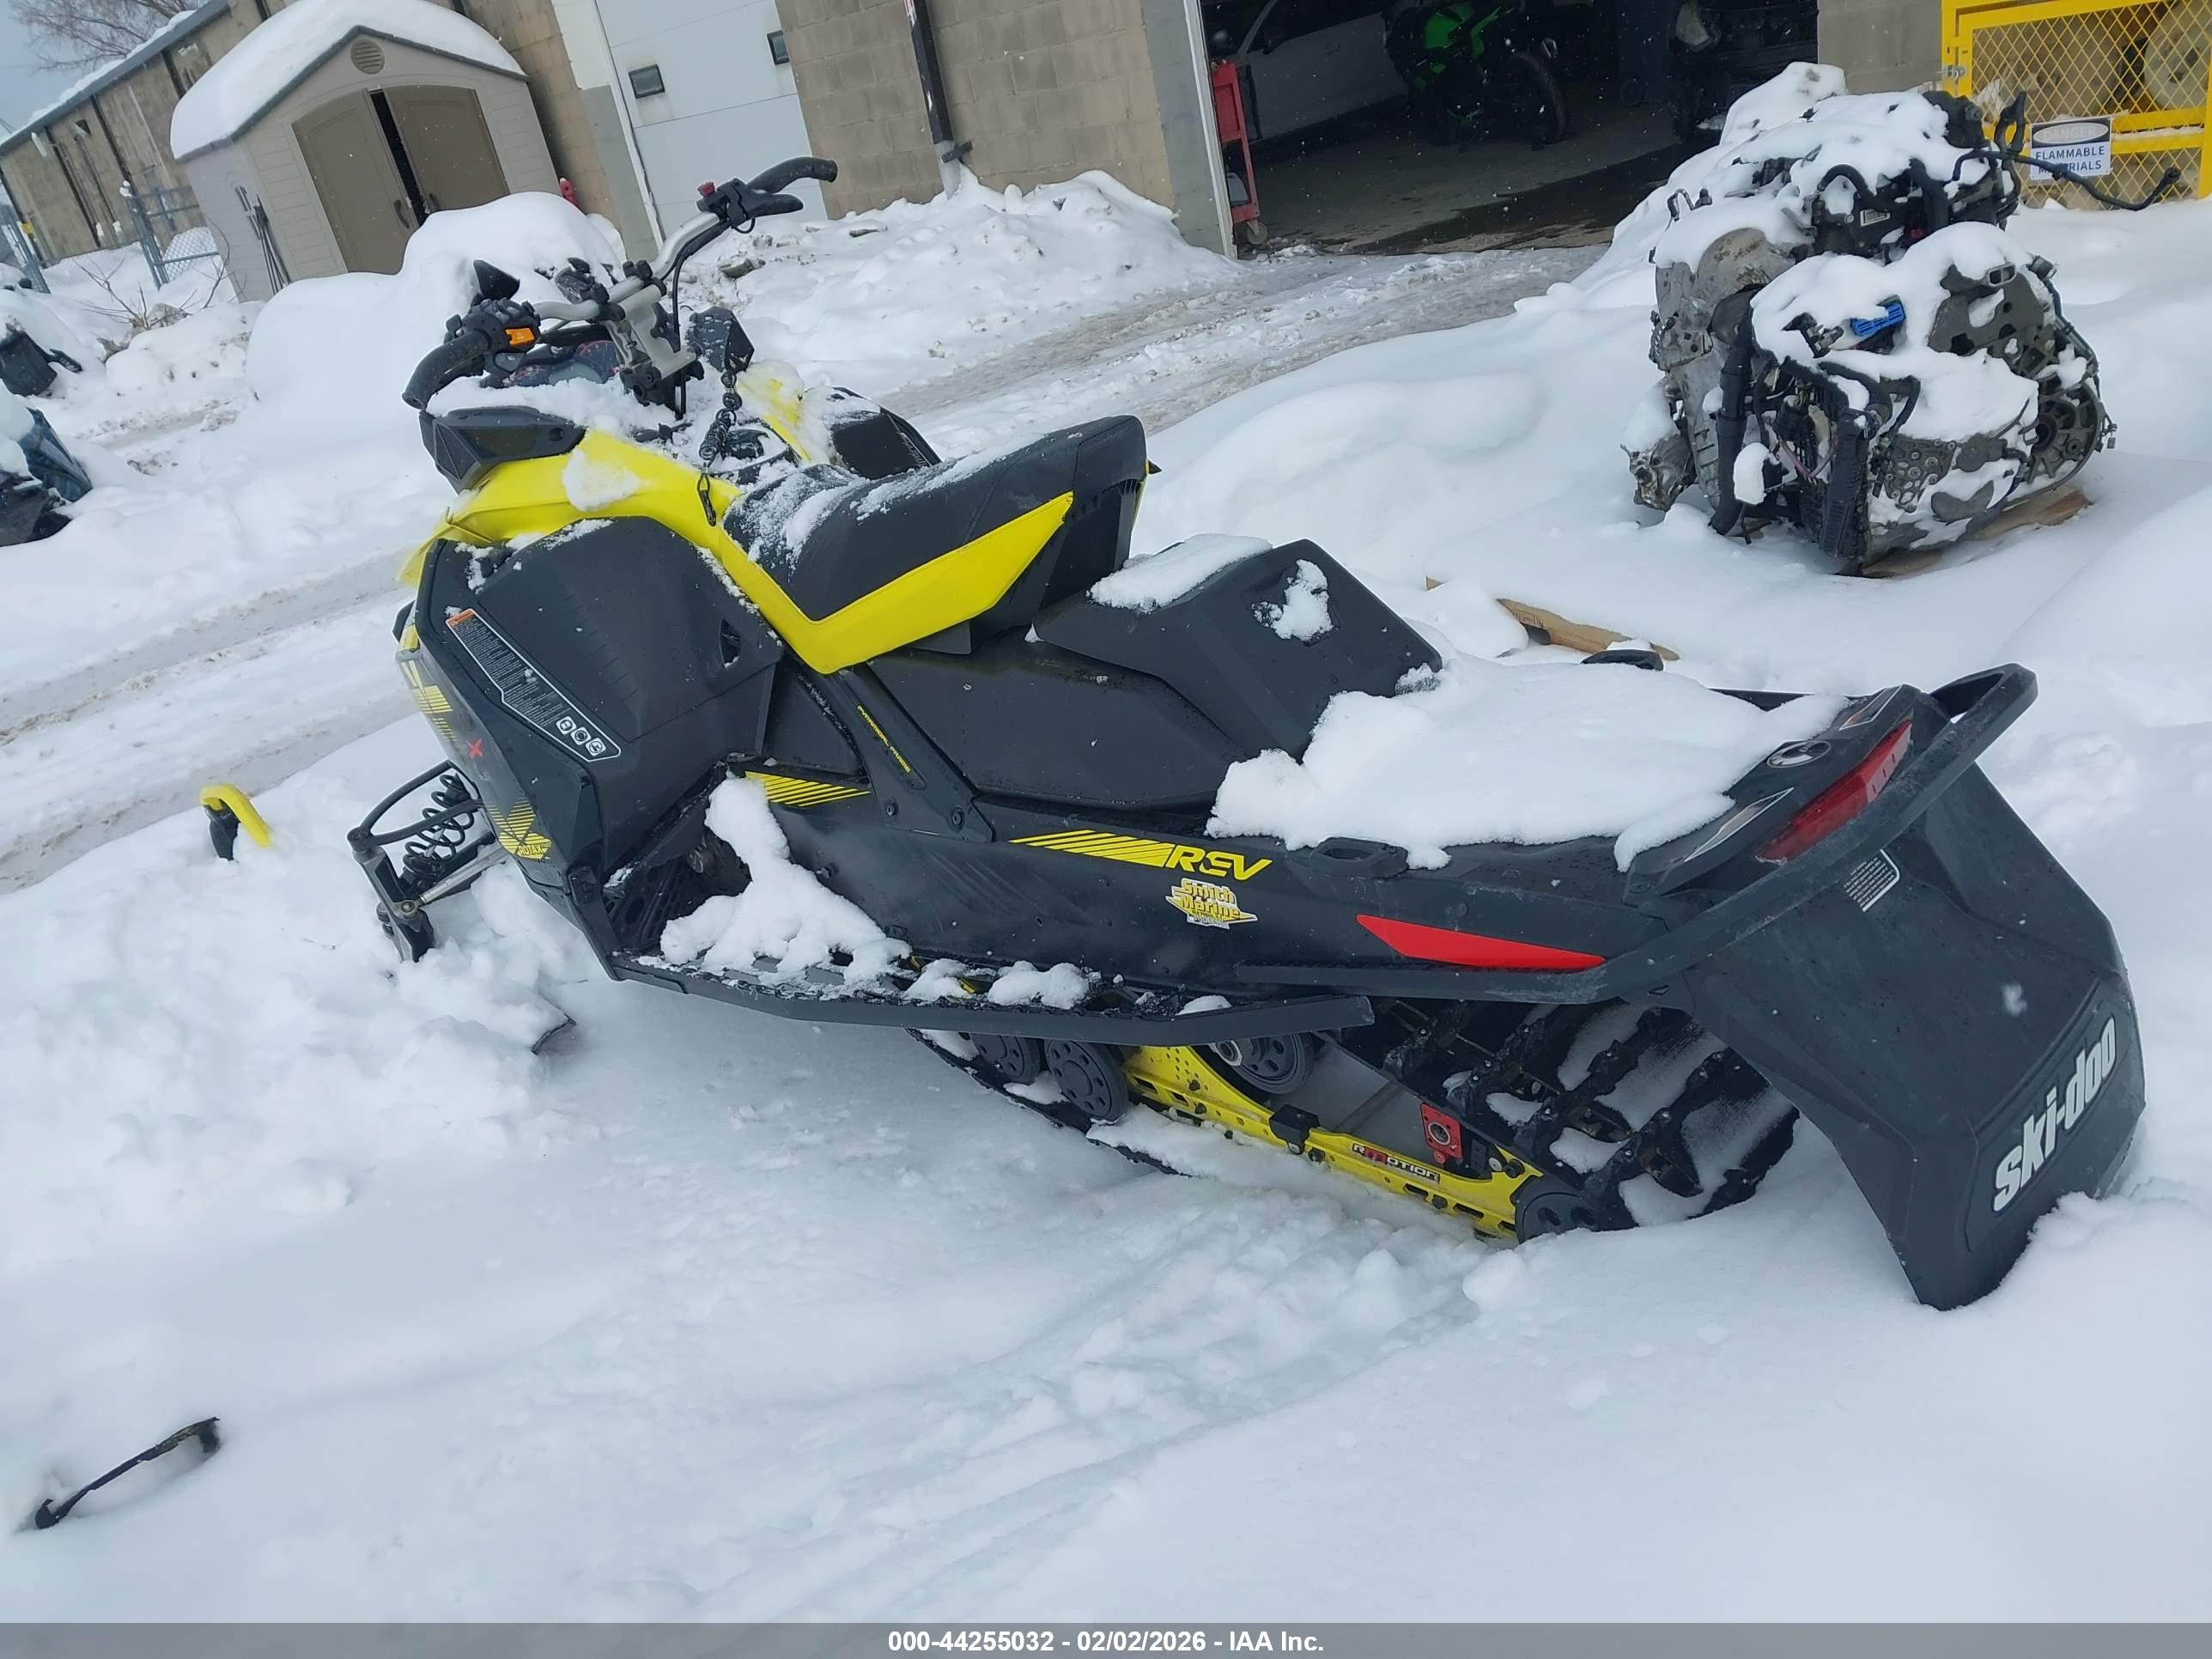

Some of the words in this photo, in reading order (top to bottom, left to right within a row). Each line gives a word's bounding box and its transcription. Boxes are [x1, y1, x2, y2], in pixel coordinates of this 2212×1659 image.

[2035, 145, 2106, 161] FLAMMABLE
[2039, 160, 2102, 174] MRIALS
[1182, 878, 1236, 904] Smith
[1181, 893, 1241, 921] Marine
[1992, 1016, 2117, 1212] ski-doo
